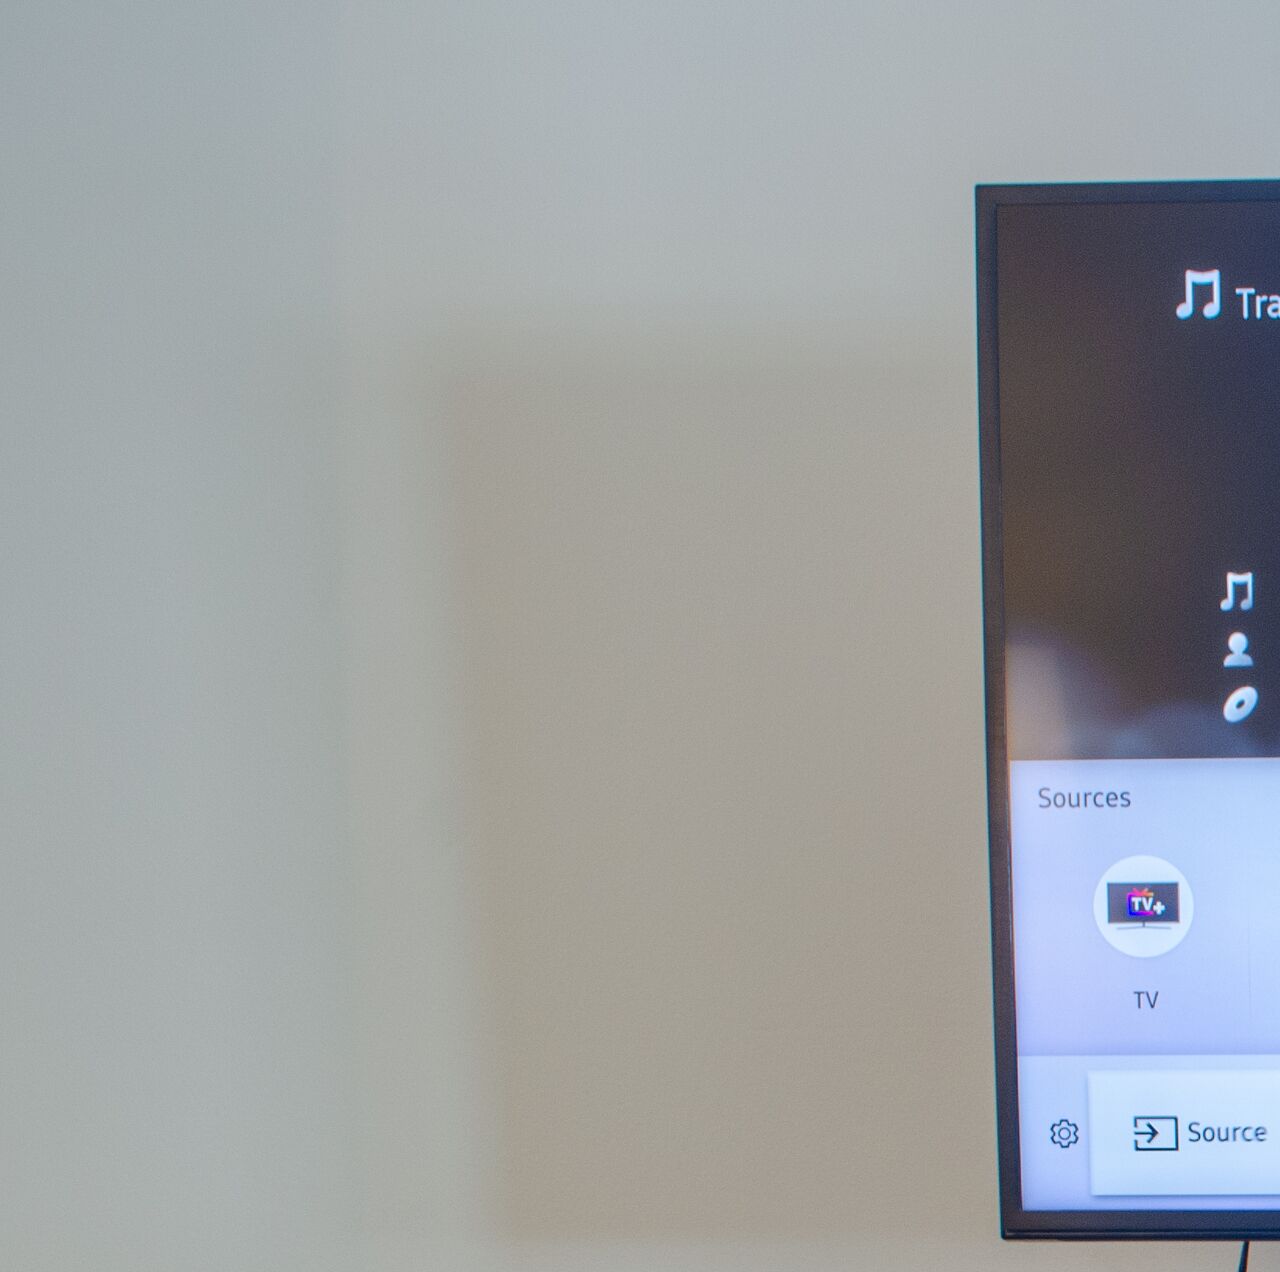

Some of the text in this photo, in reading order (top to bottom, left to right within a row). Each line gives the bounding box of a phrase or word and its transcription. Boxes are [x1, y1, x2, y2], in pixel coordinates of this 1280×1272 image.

[1038, 787, 1132, 809] Sources
[1133, 991, 1159, 1009] TV
[1188, 1122, 1268, 1142] Source
